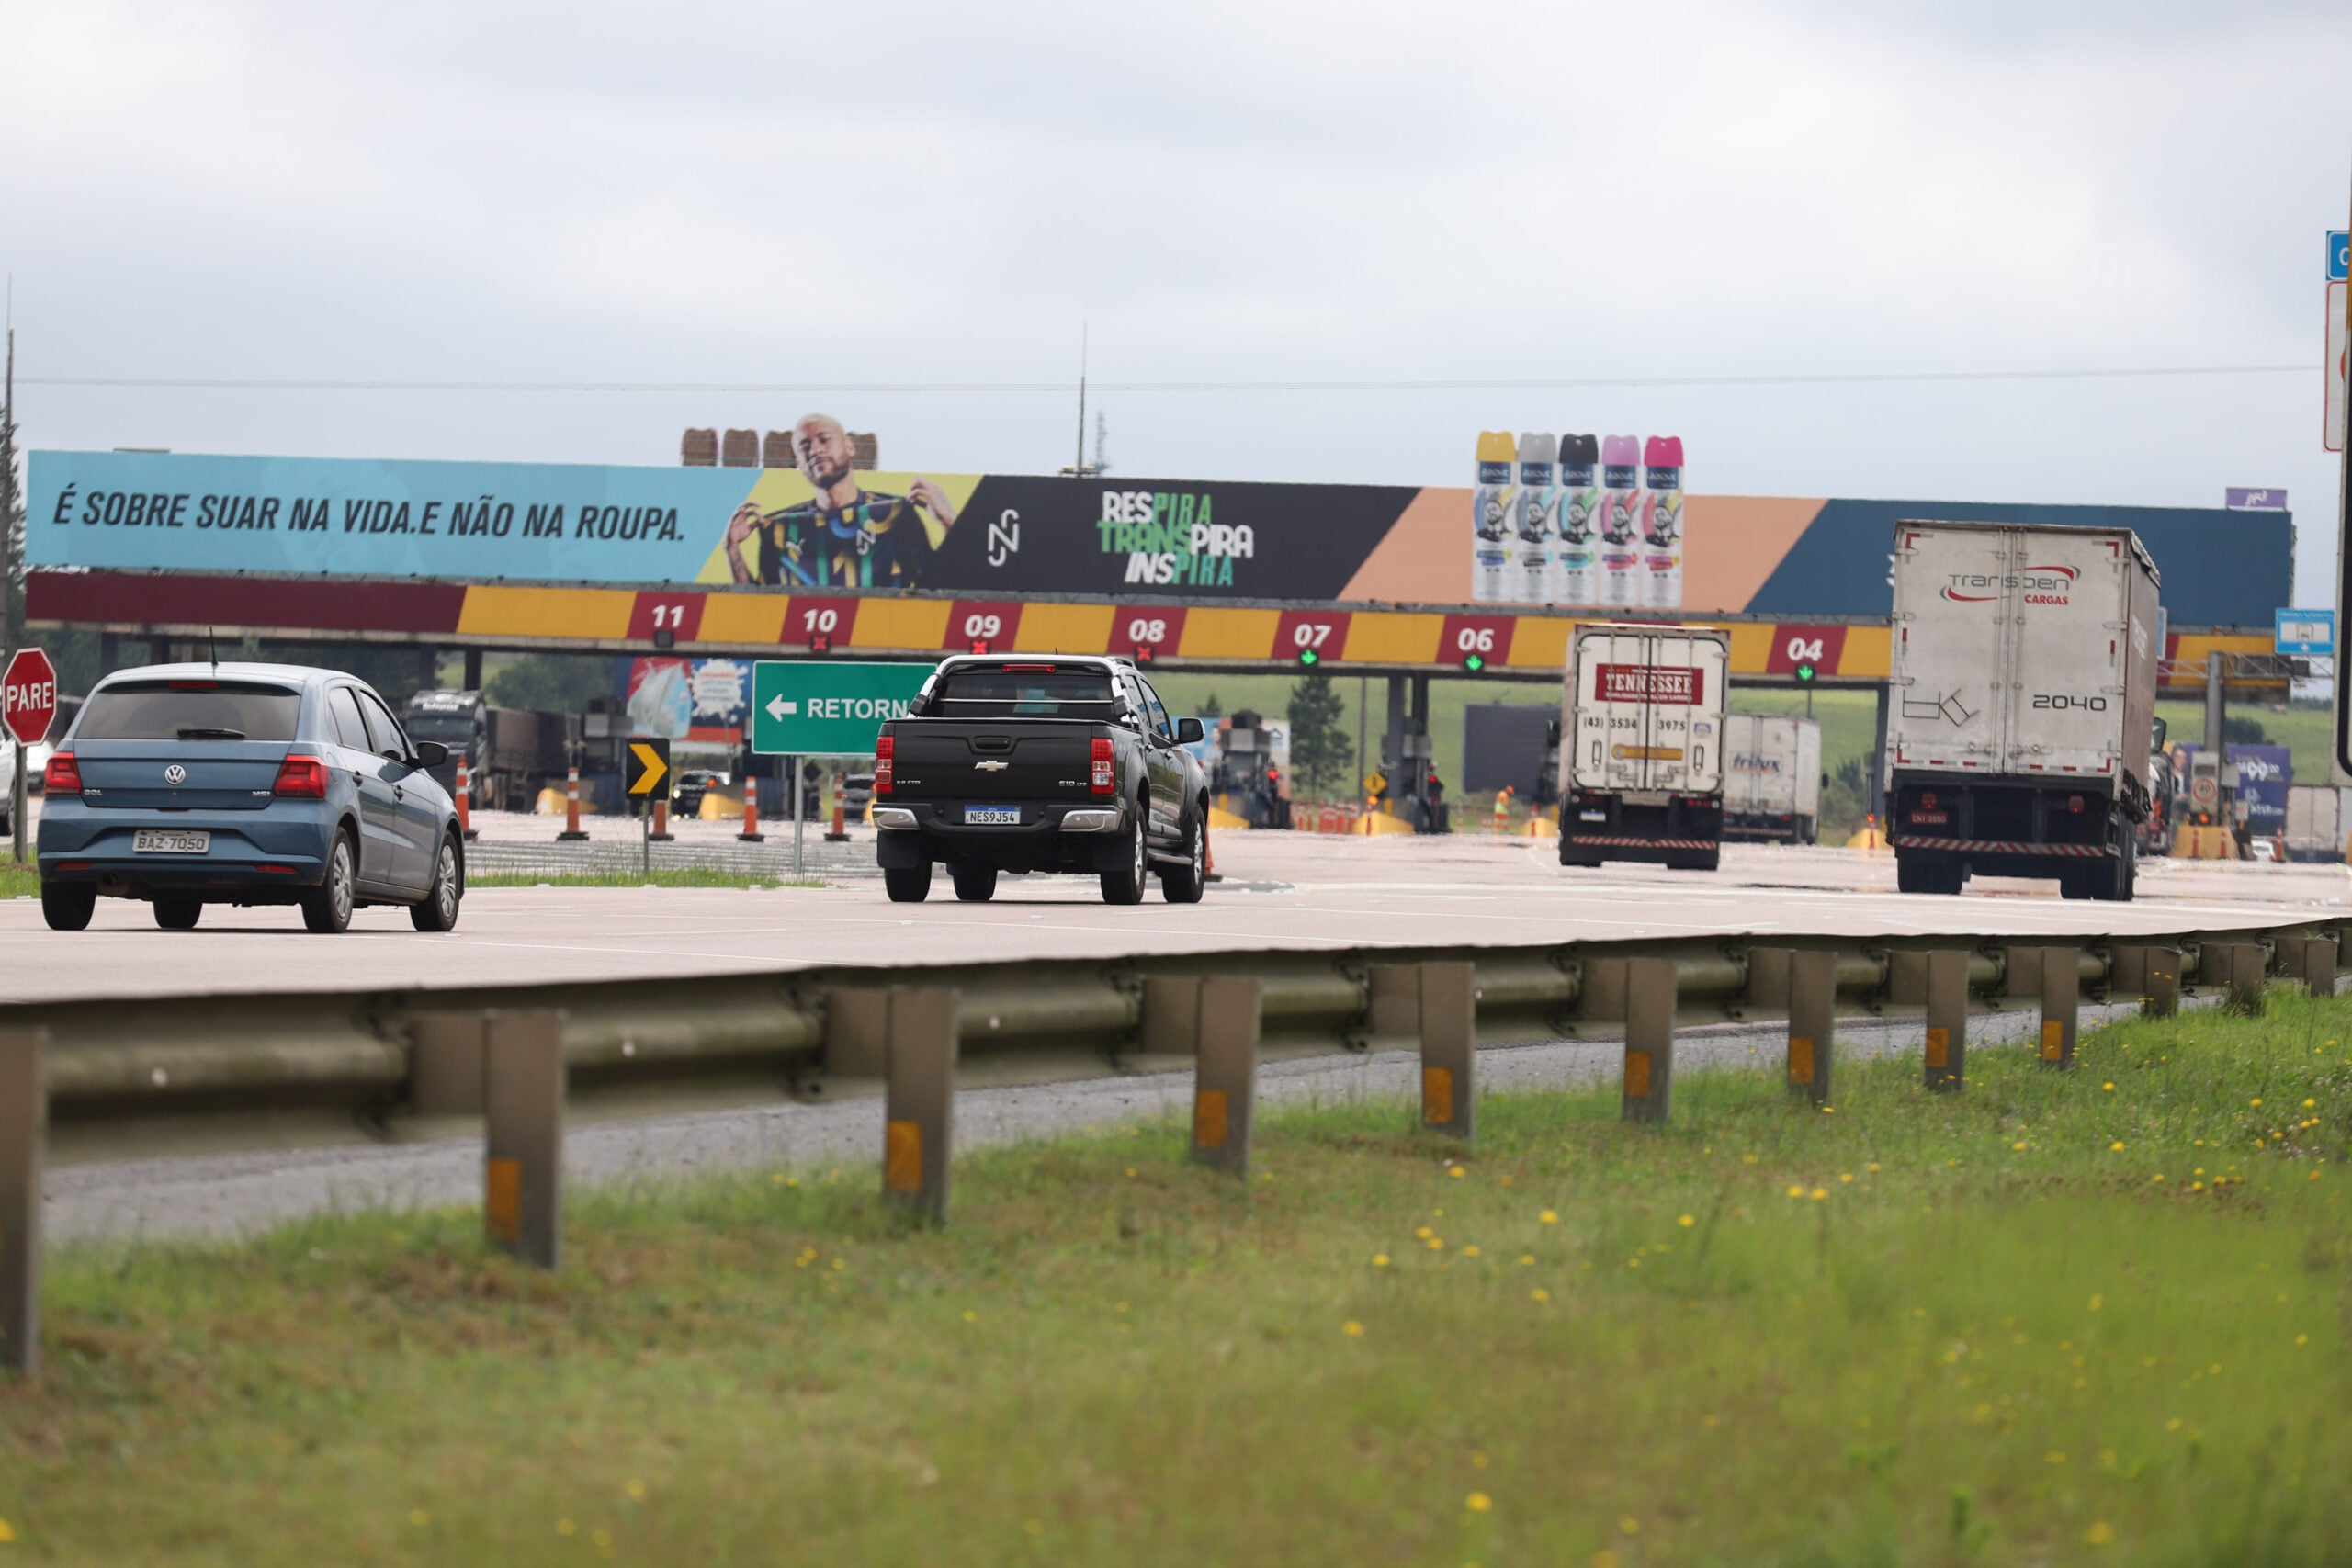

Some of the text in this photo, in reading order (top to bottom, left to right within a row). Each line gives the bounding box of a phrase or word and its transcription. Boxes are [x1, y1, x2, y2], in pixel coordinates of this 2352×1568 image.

[52, 482, 77, 525] É
[82, 491, 190, 527] SOBRE
[196, 493, 280, 530] SUAR
[288, 497, 329, 532] NA
[447, 494, 514, 537] NÃO
[522, 503, 563, 538] NA
[574, 504, 685, 542] ROUPA.
[1102, 491, 1212, 525] RESPIRA
[1096, 519, 1254, 558] TRANSPIRA
[1123, 551, 1234, 586] INSPIRA
[2024, 593, 2070, 605] CARGAS
[651, 604, 684, 628] 11
[803, 608, 838, 632] 10
[965, 615, 1001, 638] 09
[1128, 619, 1166, 643] 08
[1294, 624, 1332, 648] 07
[1457, 628, 1495, 652] 06
[1787, 637, 1824, 662] 04
[1606, 672, 1693, 694] TENNESSEE
[6, 681, 52, 713] PARE
[808, 697, 909, 719] RETORN
[2032, 694, 2107, 712] 2040
[970, 811, 1015, 823] NES9J54
